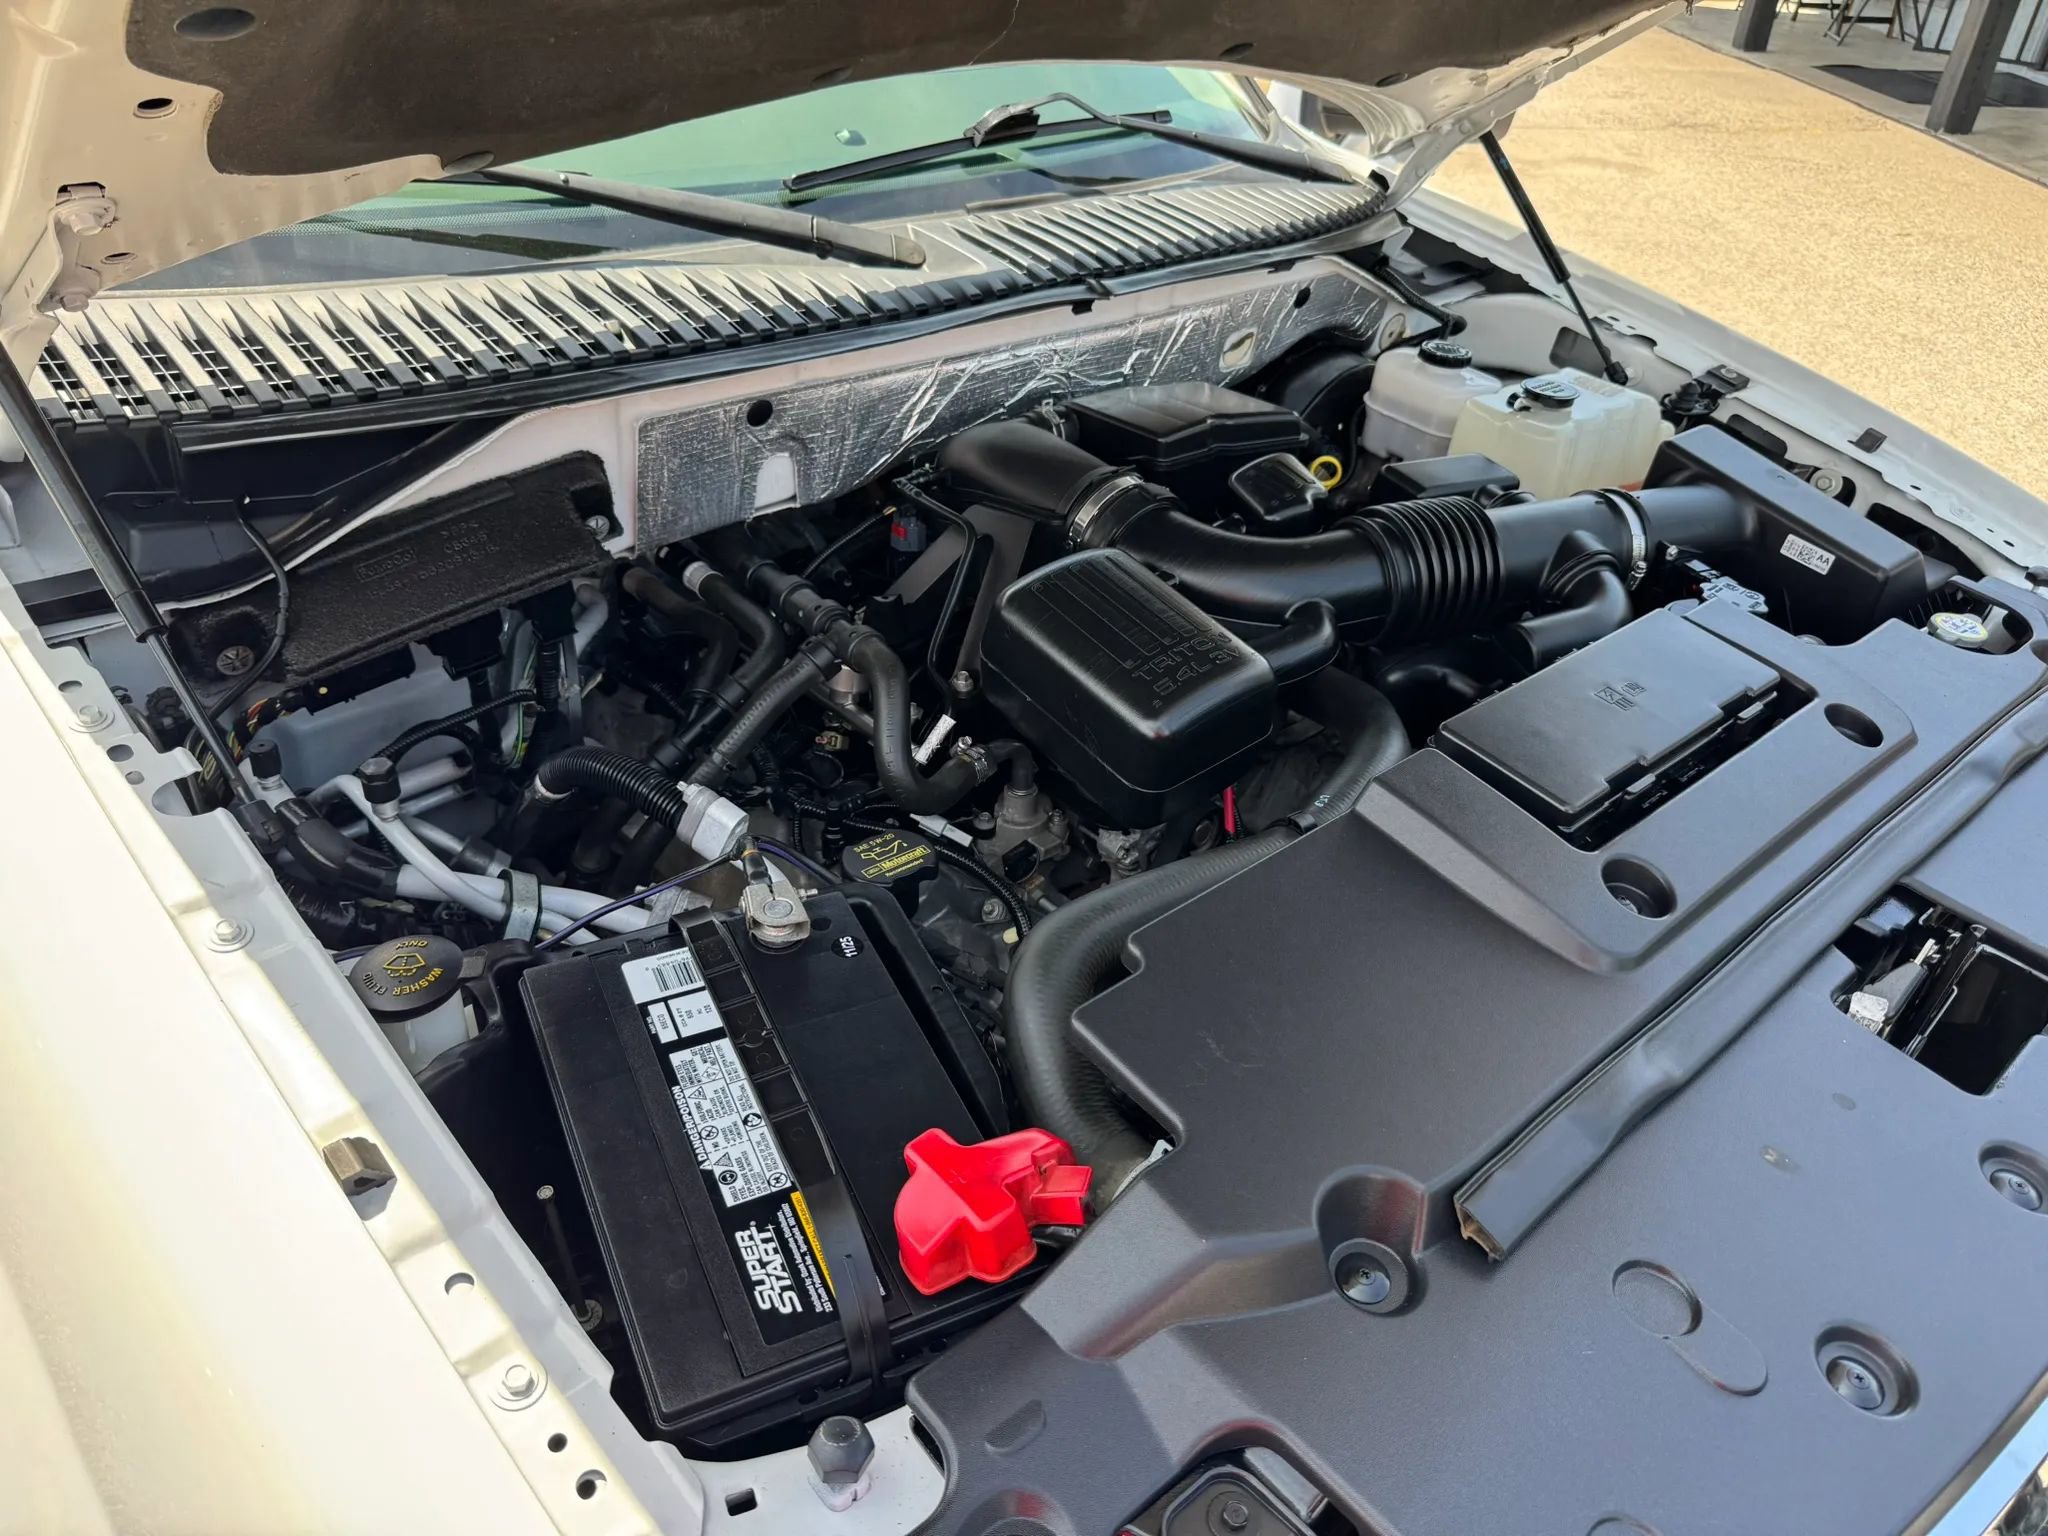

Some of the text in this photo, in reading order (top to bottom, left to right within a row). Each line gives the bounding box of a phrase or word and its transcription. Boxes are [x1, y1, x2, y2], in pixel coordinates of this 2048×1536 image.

[1816, 554, 1829, 566] AA
[1131, 631, 1232, 680] TRITON
[1153, 661, 1211, 695] 5.4L
[853, 843, 871, 853] SAE
[881, 846, 927, 869] Motorcraft
[396, 940, 428, 950] ONLY
[363, 967, 444, 996] WASHER FLUID
[672, 1085, 708, 1162] DANGER/POISON
[735, 1230, 779, 1310] SUPER
[750, 1226, 803, 1314] START
